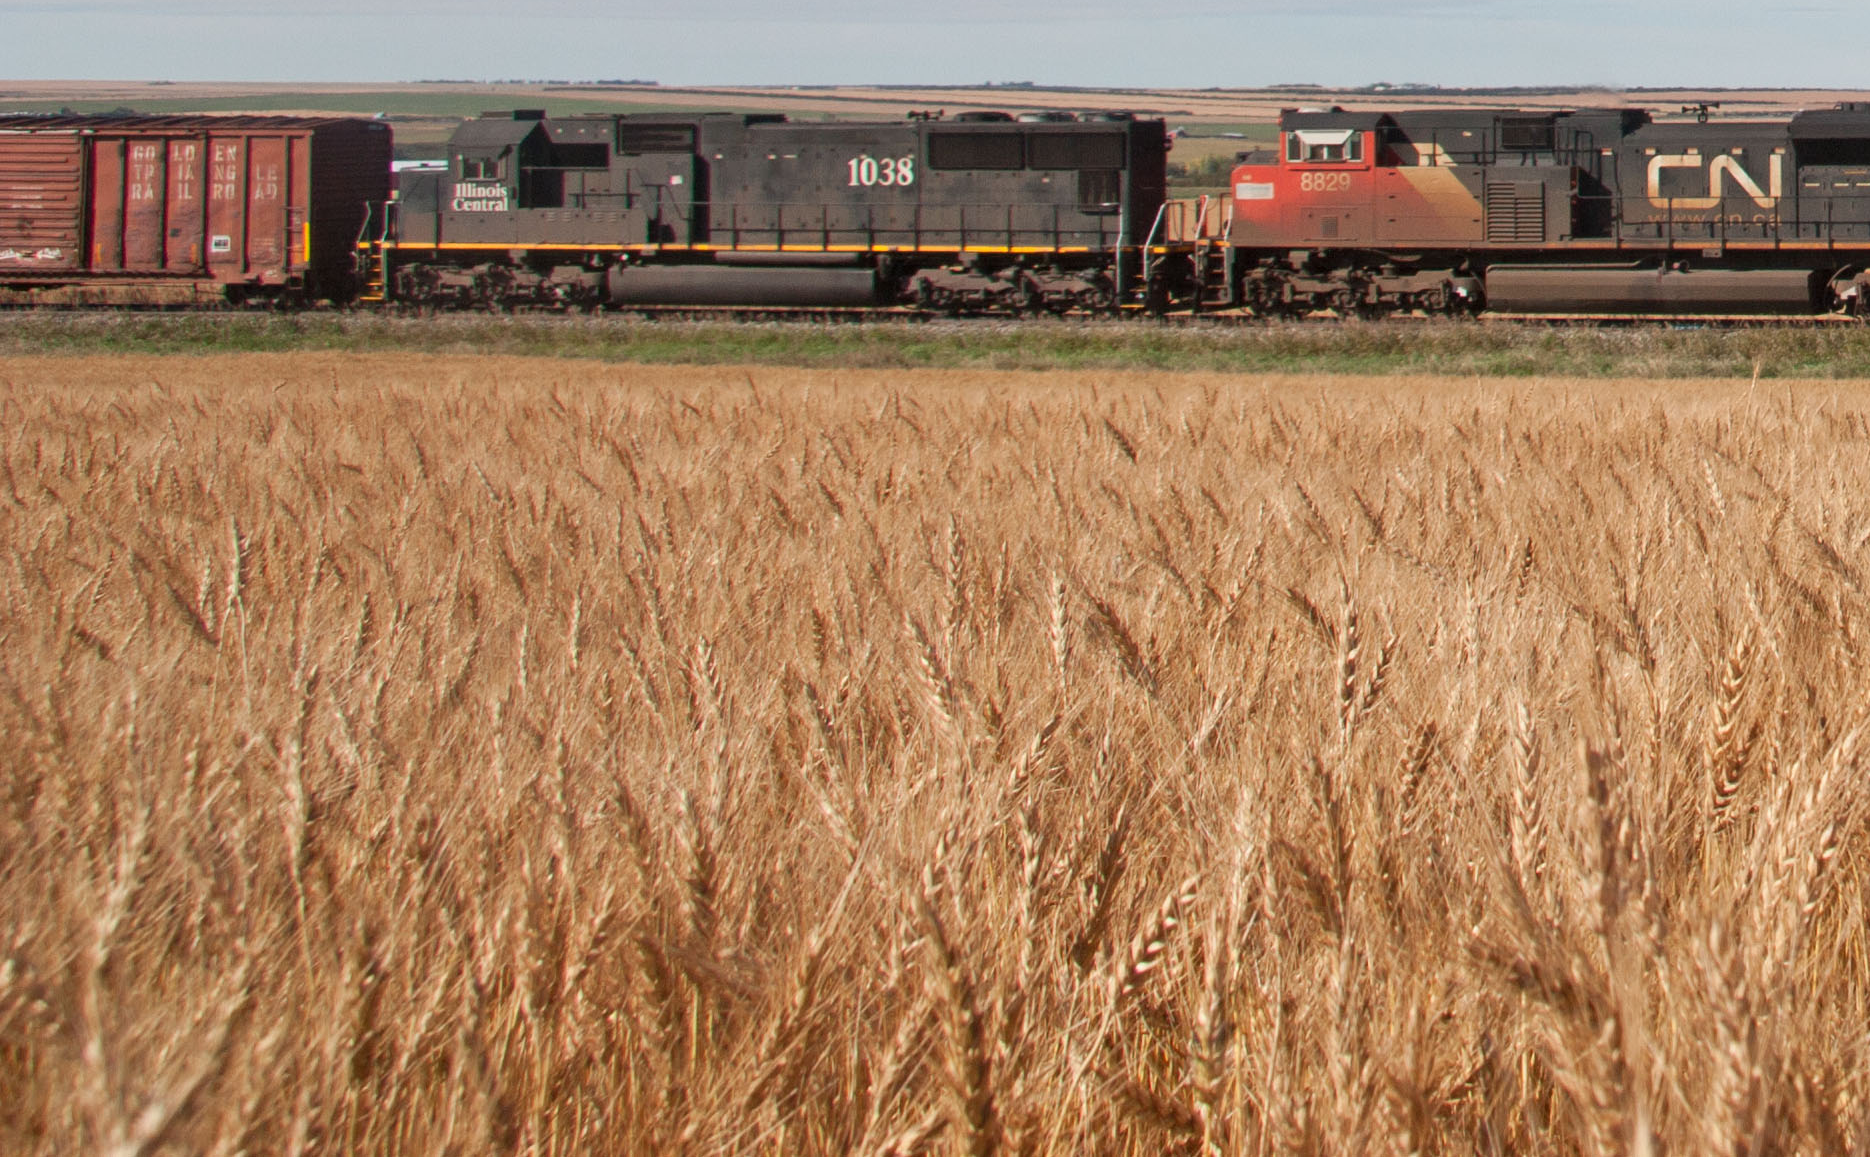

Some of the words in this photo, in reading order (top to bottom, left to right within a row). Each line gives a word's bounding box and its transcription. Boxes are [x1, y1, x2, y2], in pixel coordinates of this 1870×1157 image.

[847, 157, 914, 186] 1038
[454, 182, 508, 197] Illinois
[1300, 172, 1351, 191] 8829
[1647, 154, 1782, 209] CN
[452, 197, 509, 211] Central
[1647, 214, 1782, 226] wwwcn.ca
